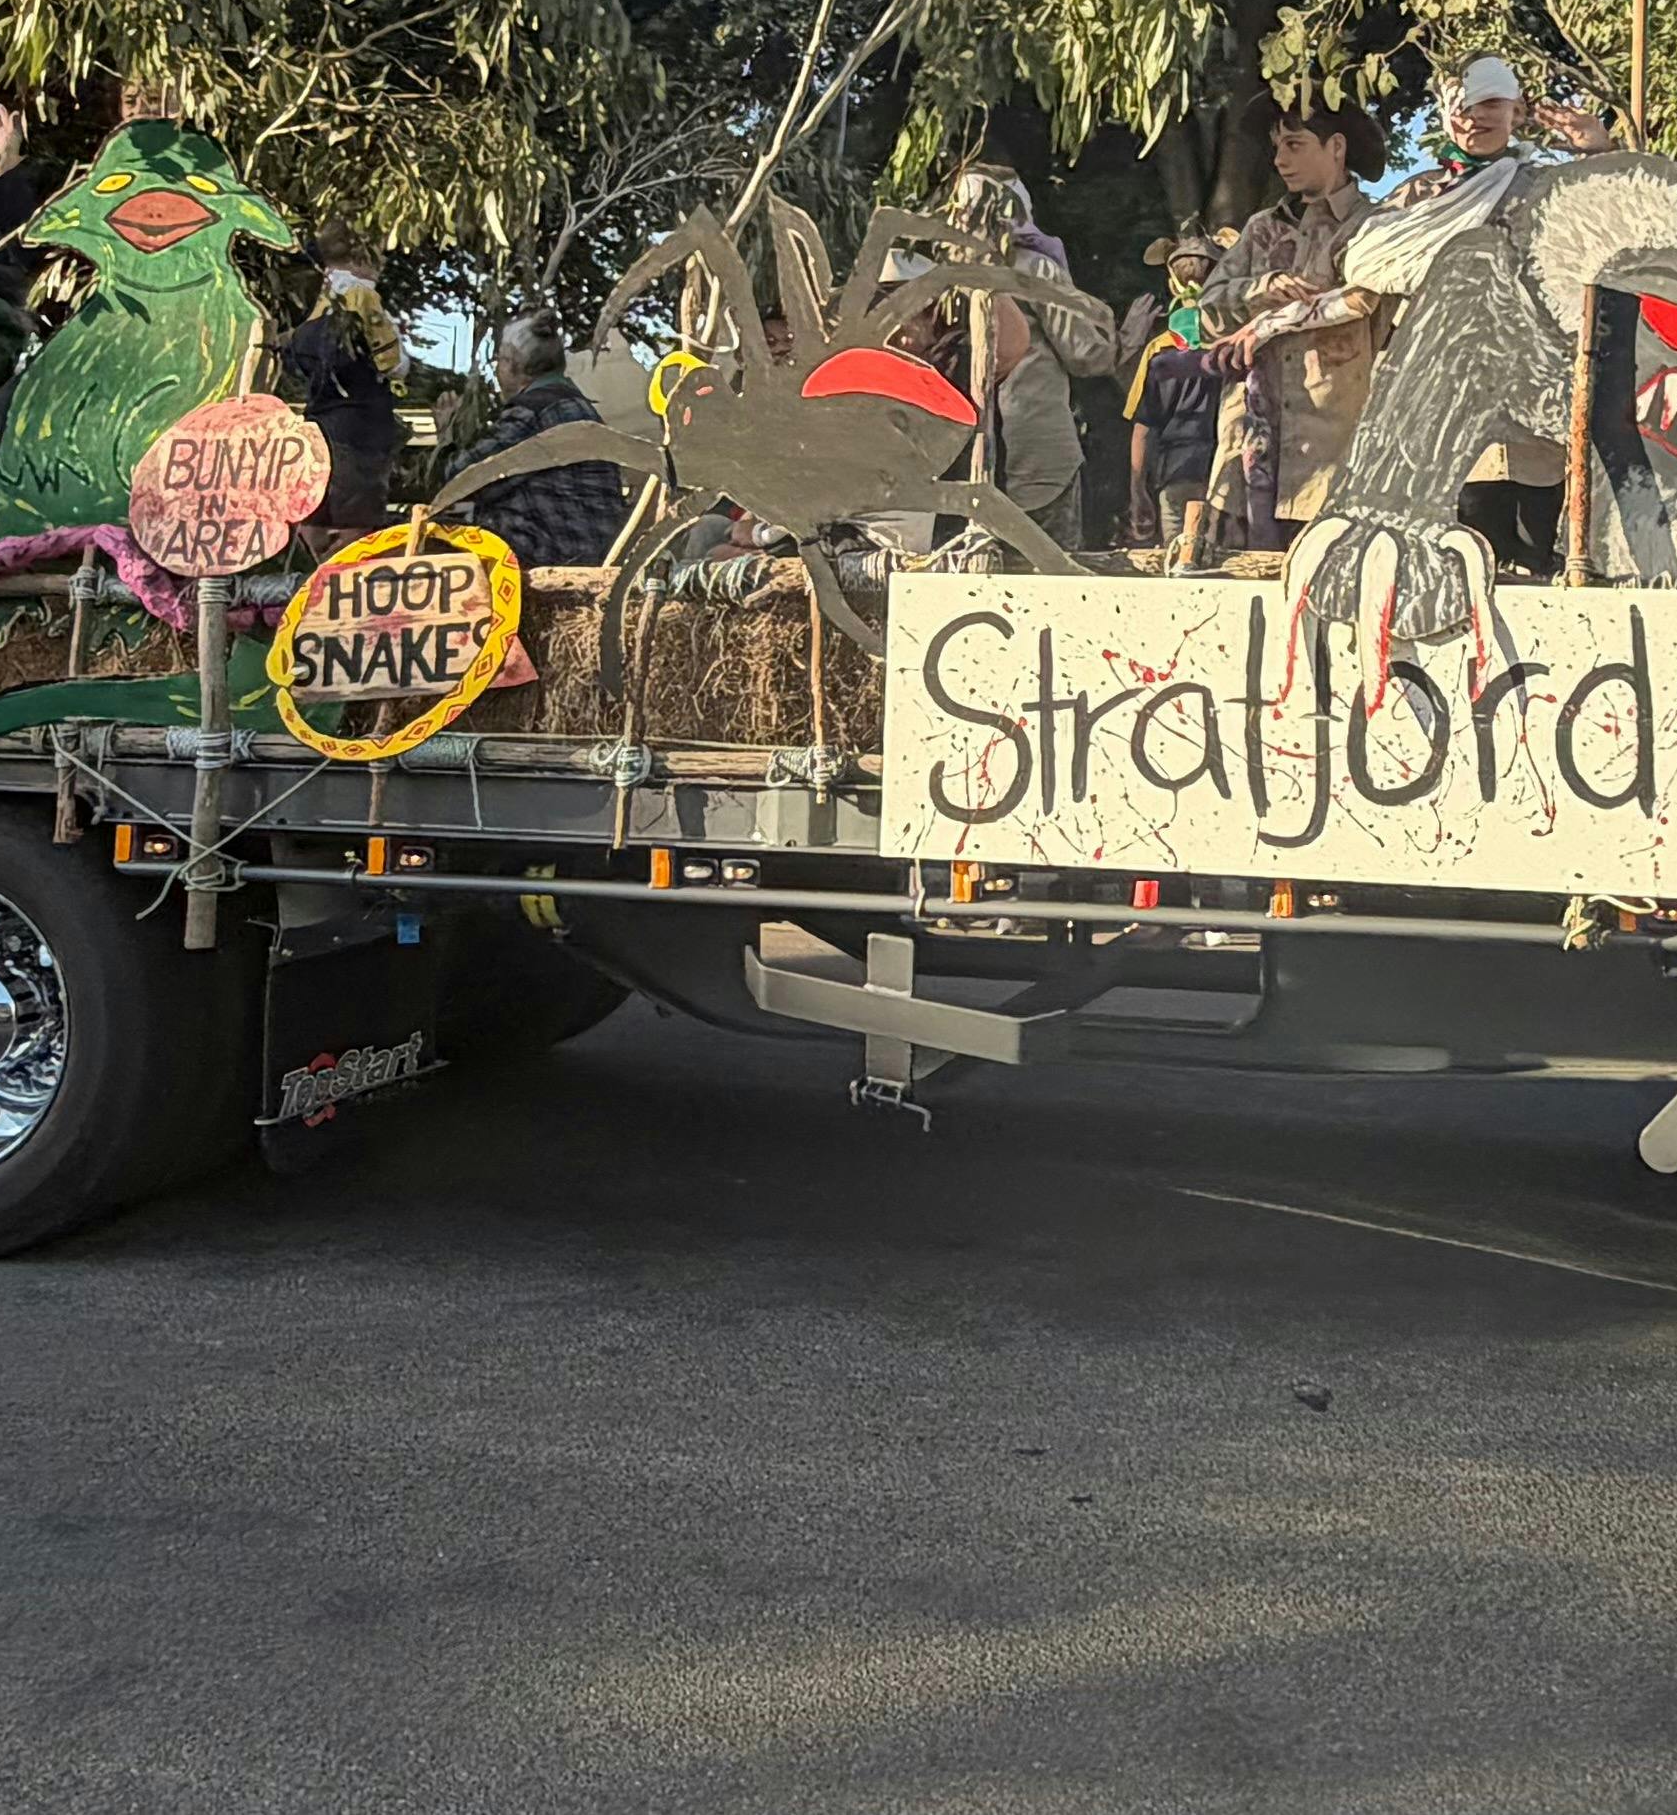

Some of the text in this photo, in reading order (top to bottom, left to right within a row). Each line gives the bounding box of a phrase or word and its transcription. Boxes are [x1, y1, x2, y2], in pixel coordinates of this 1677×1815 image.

[163, 436, 306, 492] BUNYIP
[196, 493, 226, 520] IN
[160, 518, 267, 567] AREA
[328, 559, 476, 621] HOOP
[923, 595, 1658, 849] Stratford
[278, 1030, 424, 1120] TopStart
